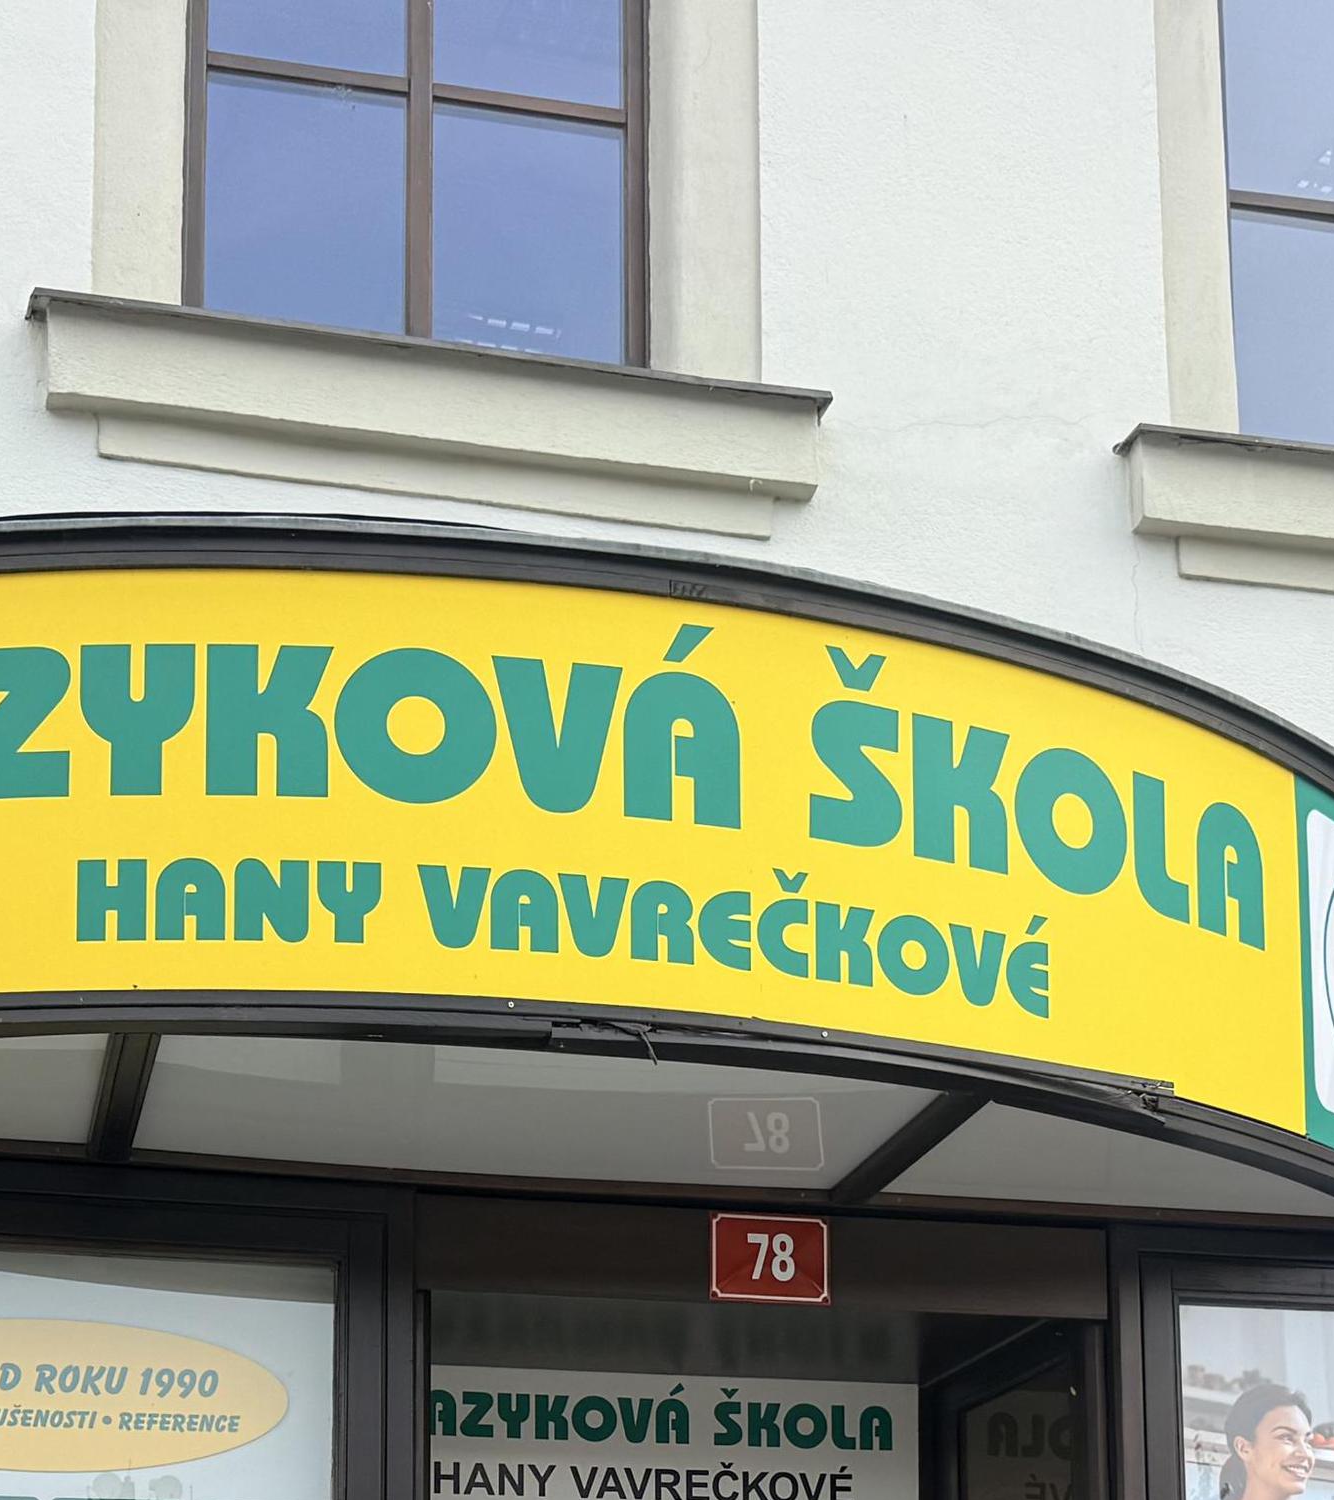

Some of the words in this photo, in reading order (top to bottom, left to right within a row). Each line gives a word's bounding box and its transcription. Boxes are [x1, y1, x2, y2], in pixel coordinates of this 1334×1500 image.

[808, 644, 1266, 951] ŠKOLA
[75, 857, 382, 943] HANY
[417, 868, 1051, 1020] VAVREČKOVÉ
[747, 1233, 795, 1281] 78
[35, 1364, 129, 1396] ROKU
[140, 1367, 219, 1399] 1990
[118, 1412, 240, 1432] REFERENCE
[713, 1387, 894, 1451] ŠKOLA
[433, 1460, 557, 1497] HANY
